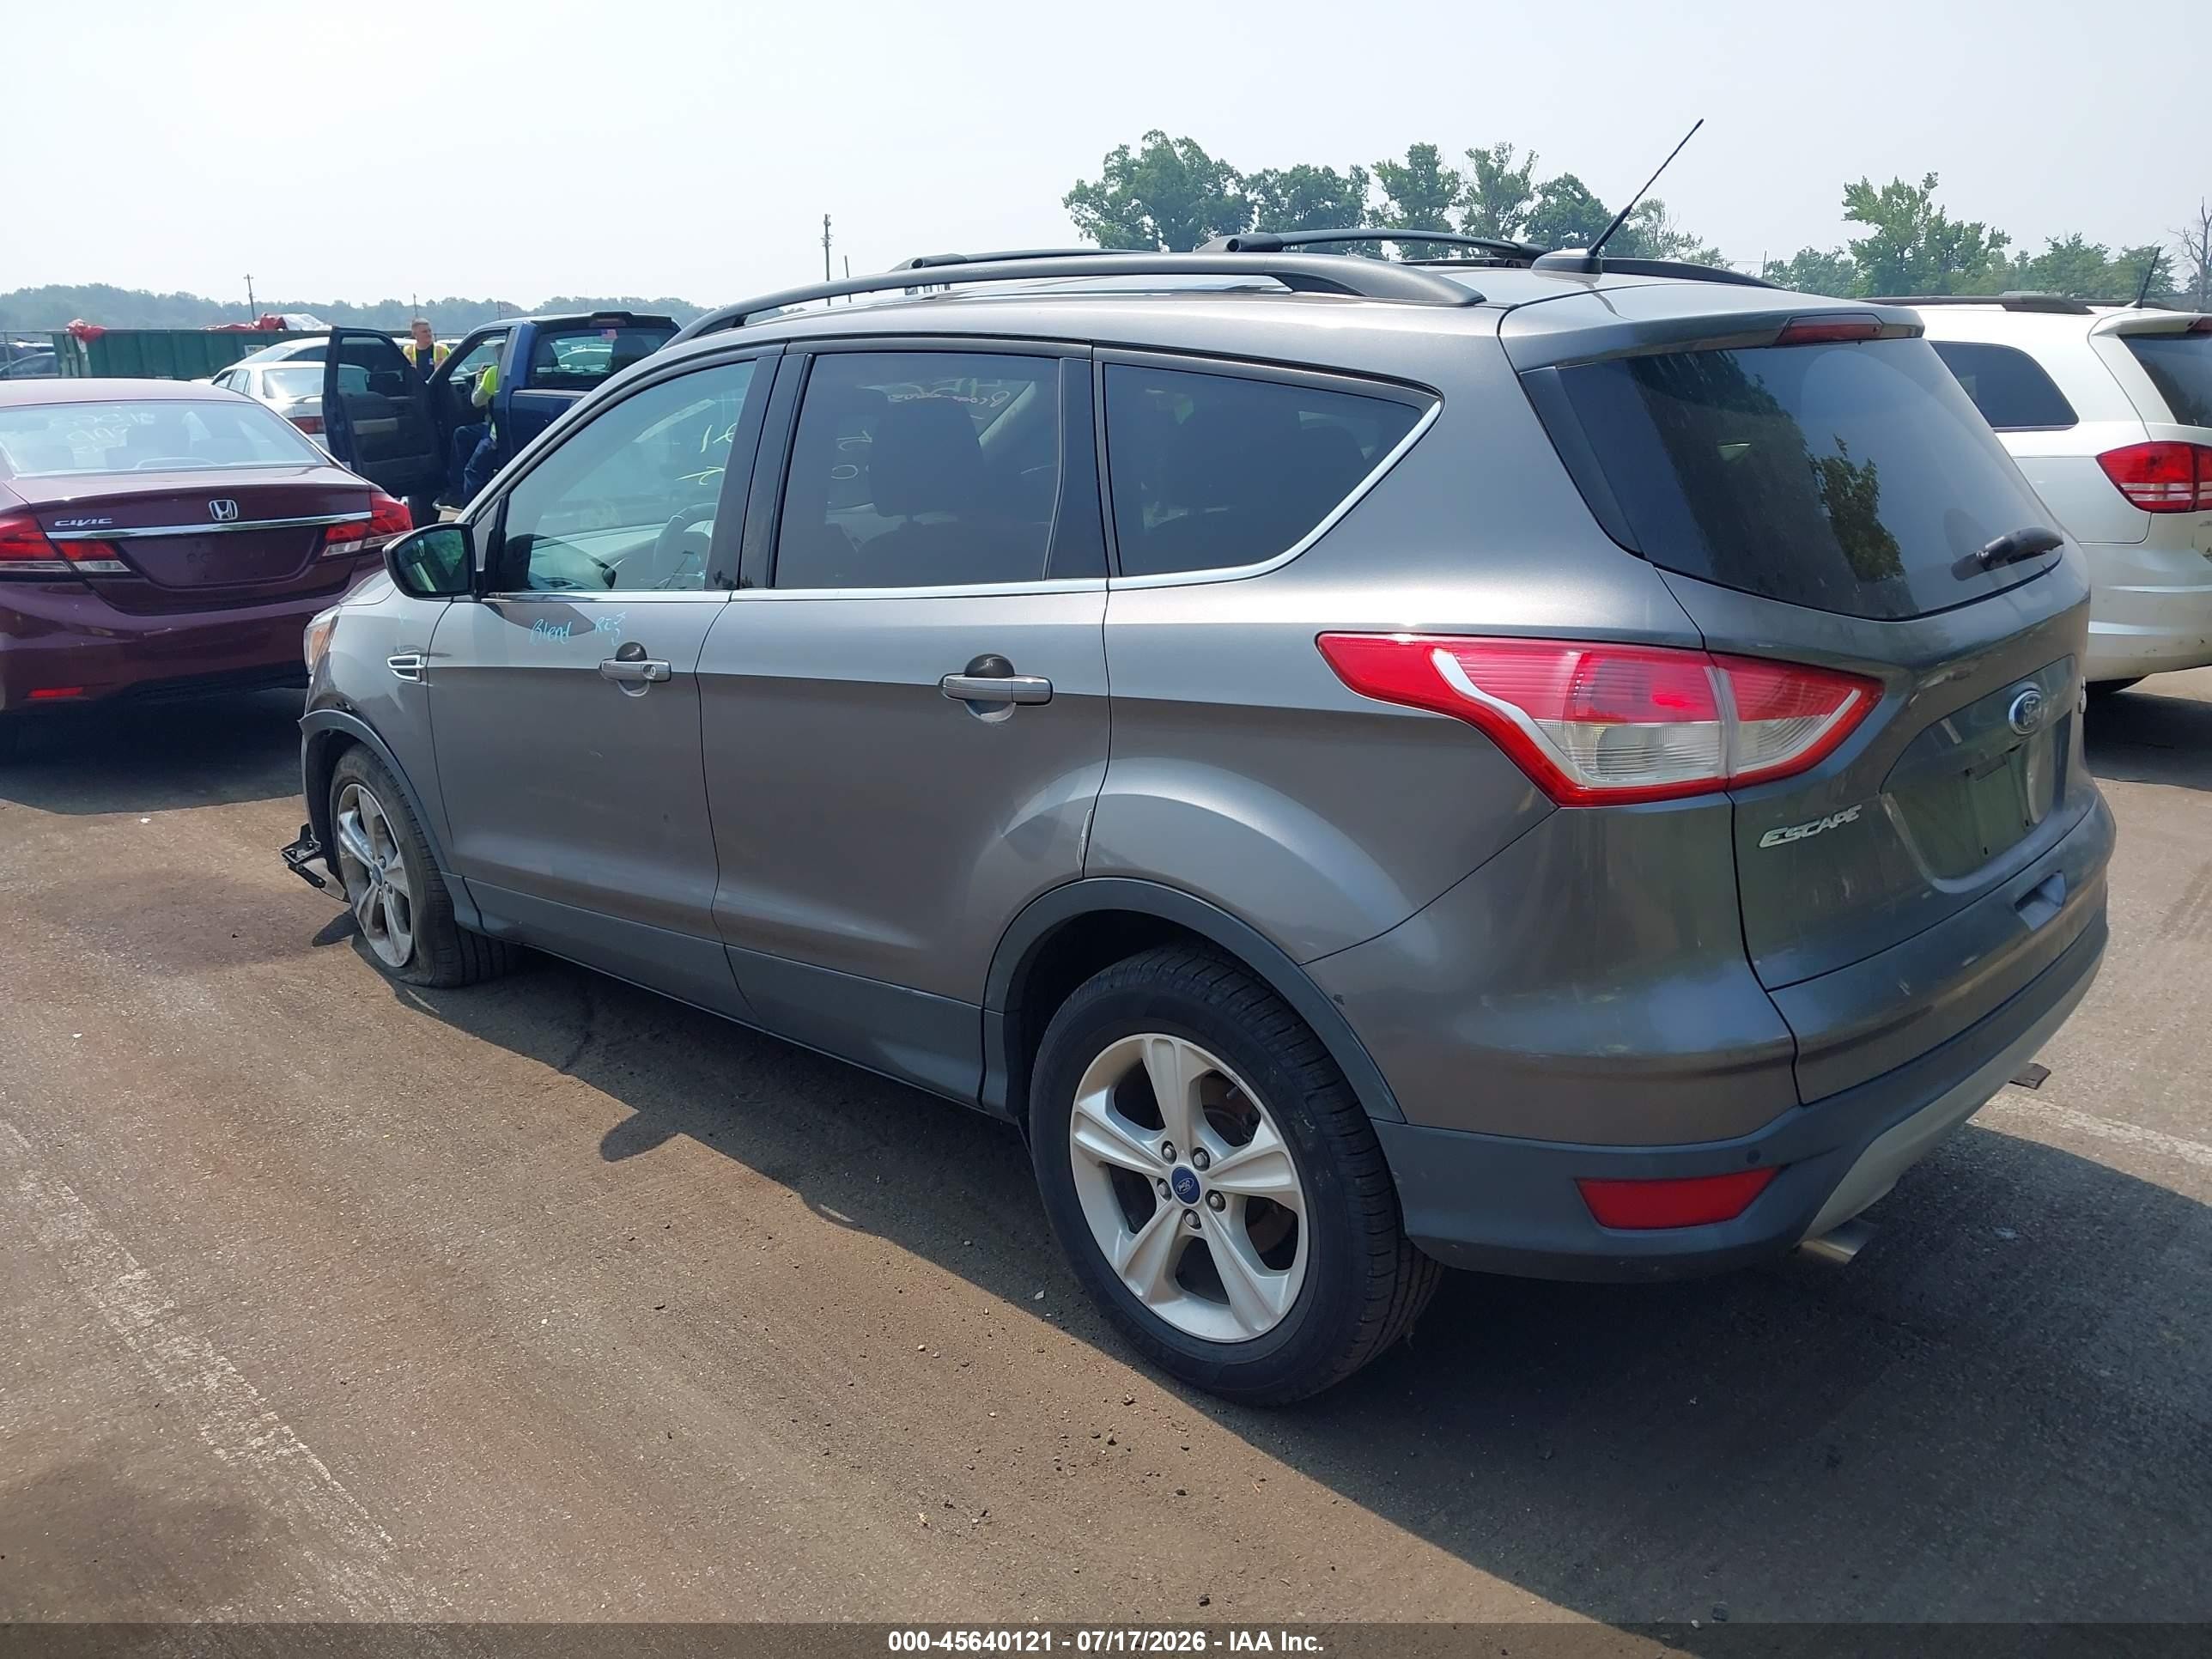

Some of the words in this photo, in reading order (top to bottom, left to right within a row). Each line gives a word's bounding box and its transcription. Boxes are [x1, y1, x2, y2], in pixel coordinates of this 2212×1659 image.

[54, 518, 113, 526] CIVIC
[529, 618, 573, 645] Blend
[1759, 804, 1863, 848] ESCAPE
